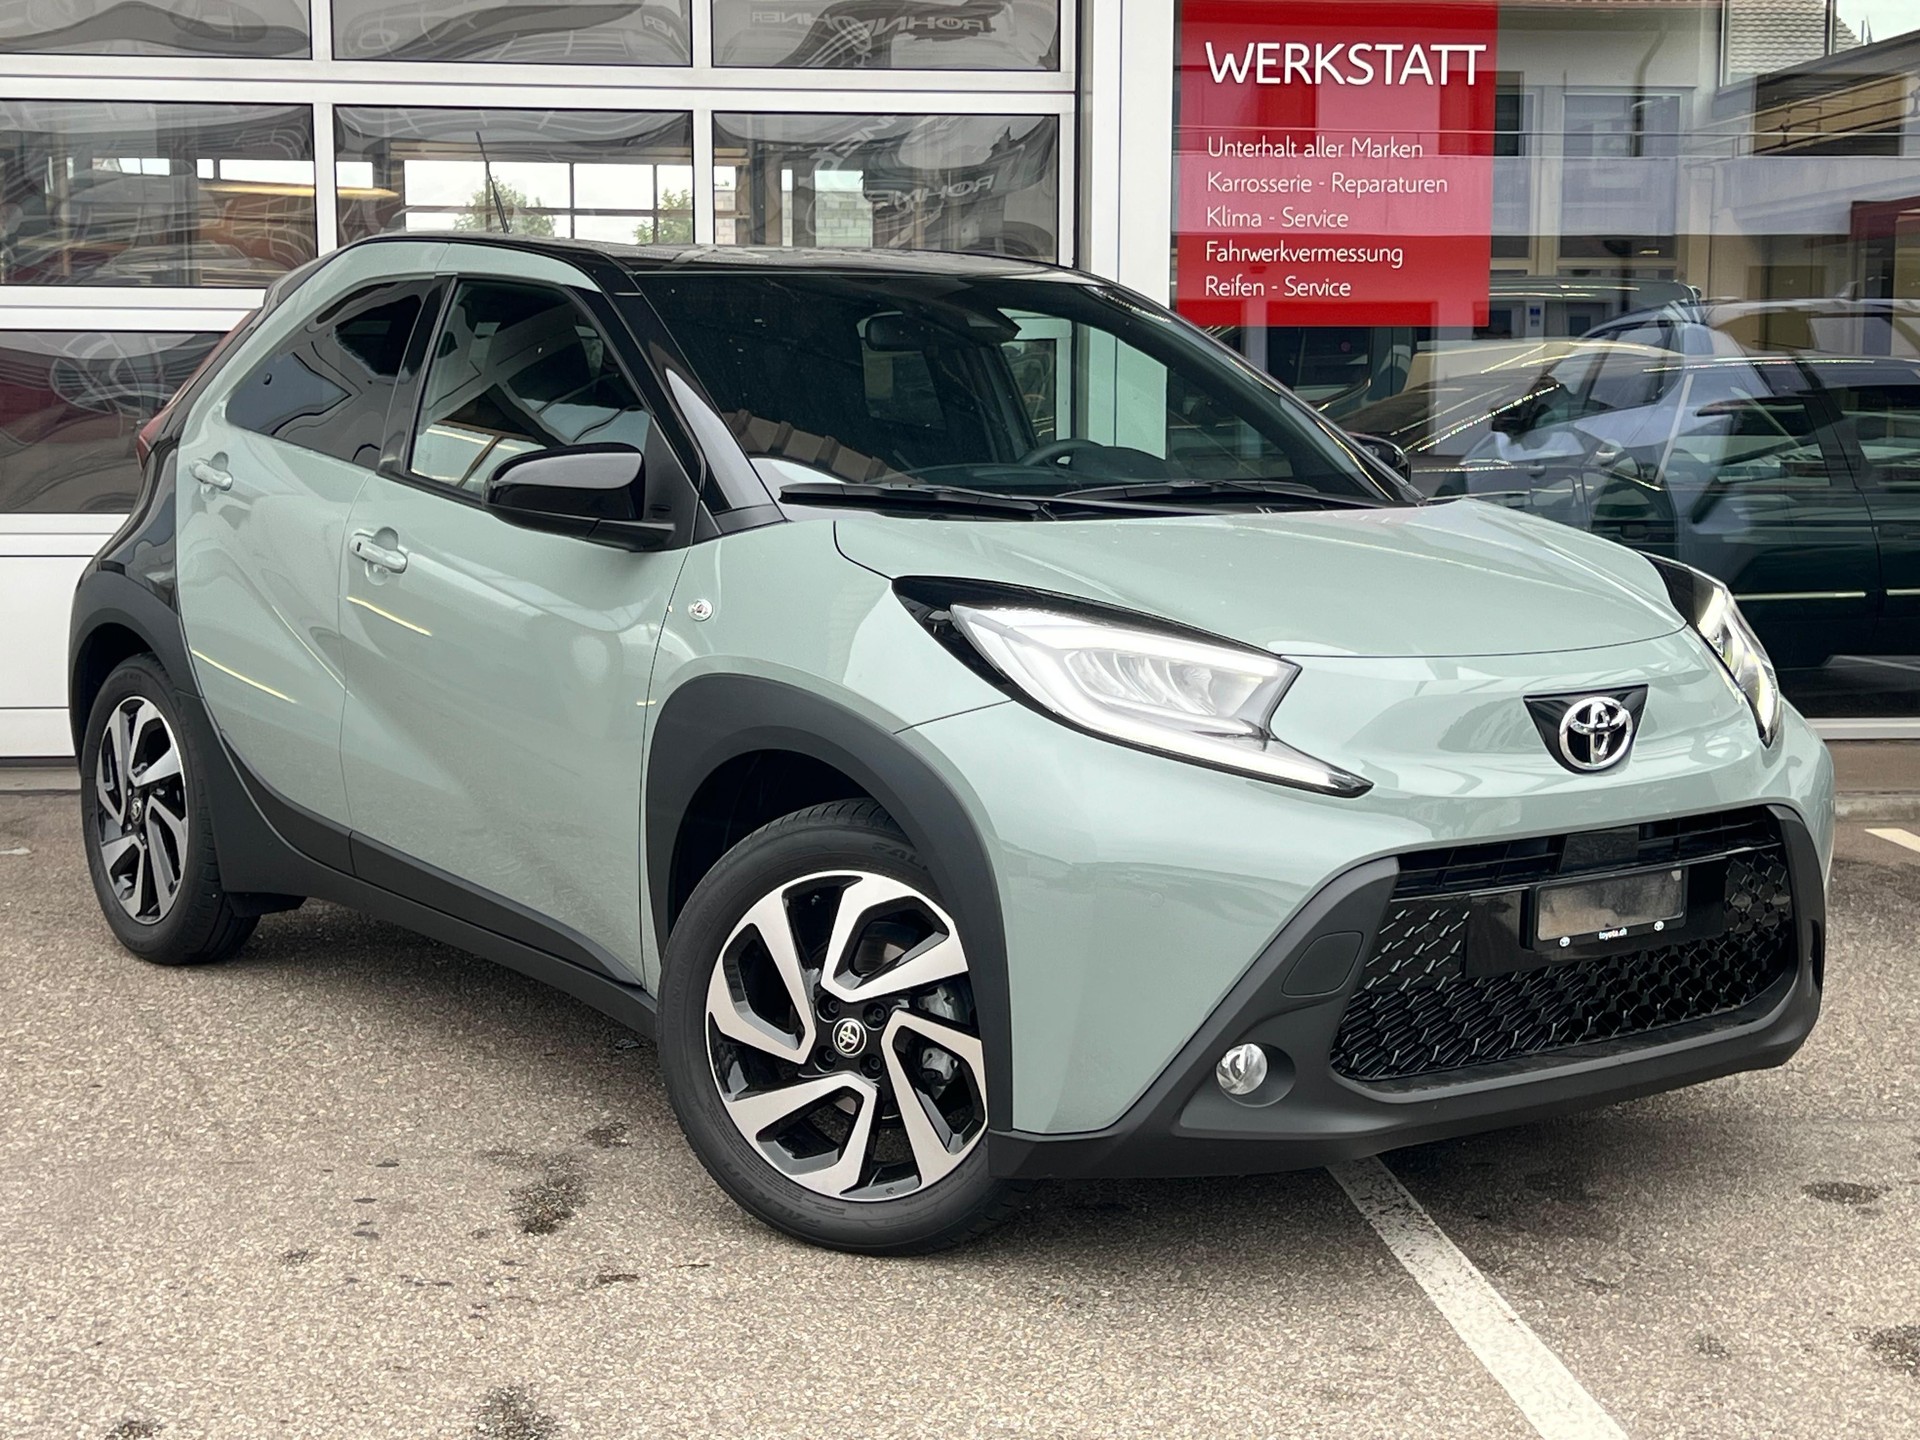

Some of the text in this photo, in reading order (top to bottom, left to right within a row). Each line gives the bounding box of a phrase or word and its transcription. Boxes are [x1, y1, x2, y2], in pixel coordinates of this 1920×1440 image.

[1205, 41, 1487, 86] WERKSTATT
[1207, 135, 1424, 159] Unterhalt aller Marken
[1206, 171, 1312, 193] Karrosserie
[1331, 172, 1448, 198] Reparaturen
[1206, 206, 1262, 228] Klima
[1281, 206, 1349, 228] Service
[1205, 240, 1404, 268] Fahrwerkvermessung
[1205, 275, 1265, 297] Reifen
[1283, 275, 1352, 297] Service
[1598, 927, 1628, 941] toyota.ch
